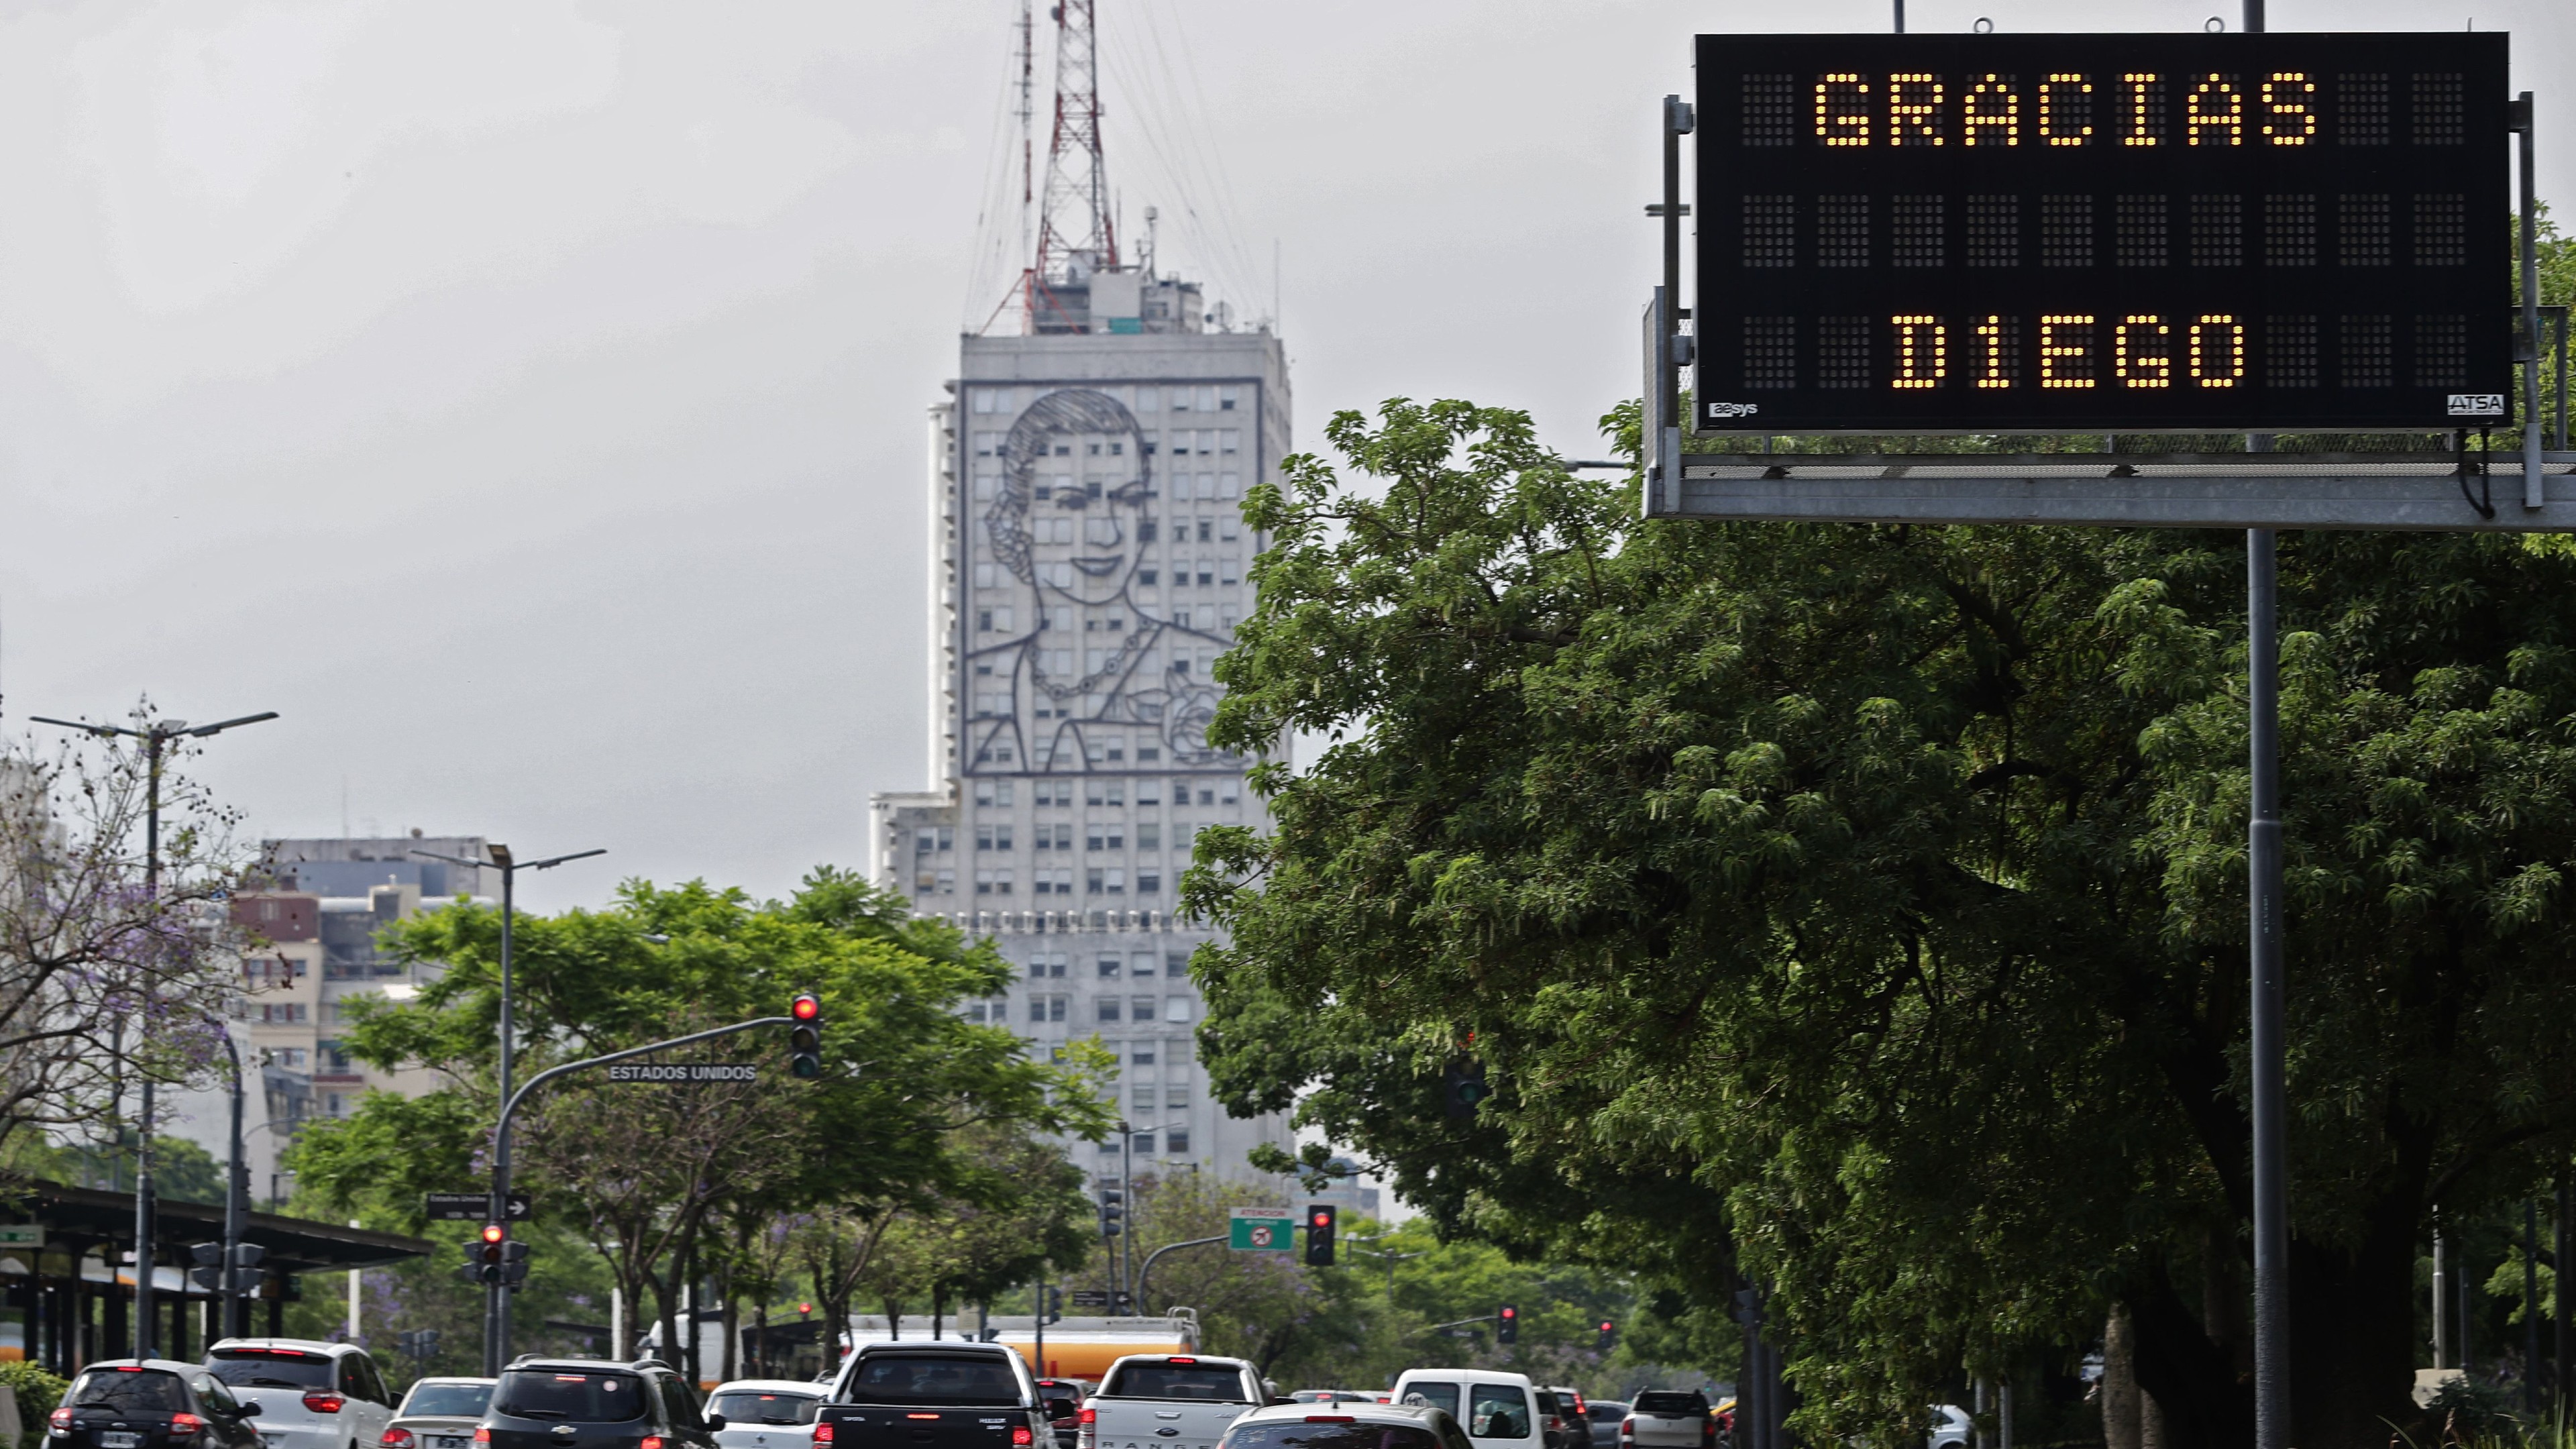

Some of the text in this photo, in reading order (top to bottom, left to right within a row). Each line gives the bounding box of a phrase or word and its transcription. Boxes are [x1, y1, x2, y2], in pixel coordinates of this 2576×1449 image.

[1815, 72, 2315, 146] GRACIAS
[2448, 395, 2504, 409] ATSA
[1713, 403, 1758, 417] aesys
[610, 1066, 756, 1079] ESTADOS UNIDOS
